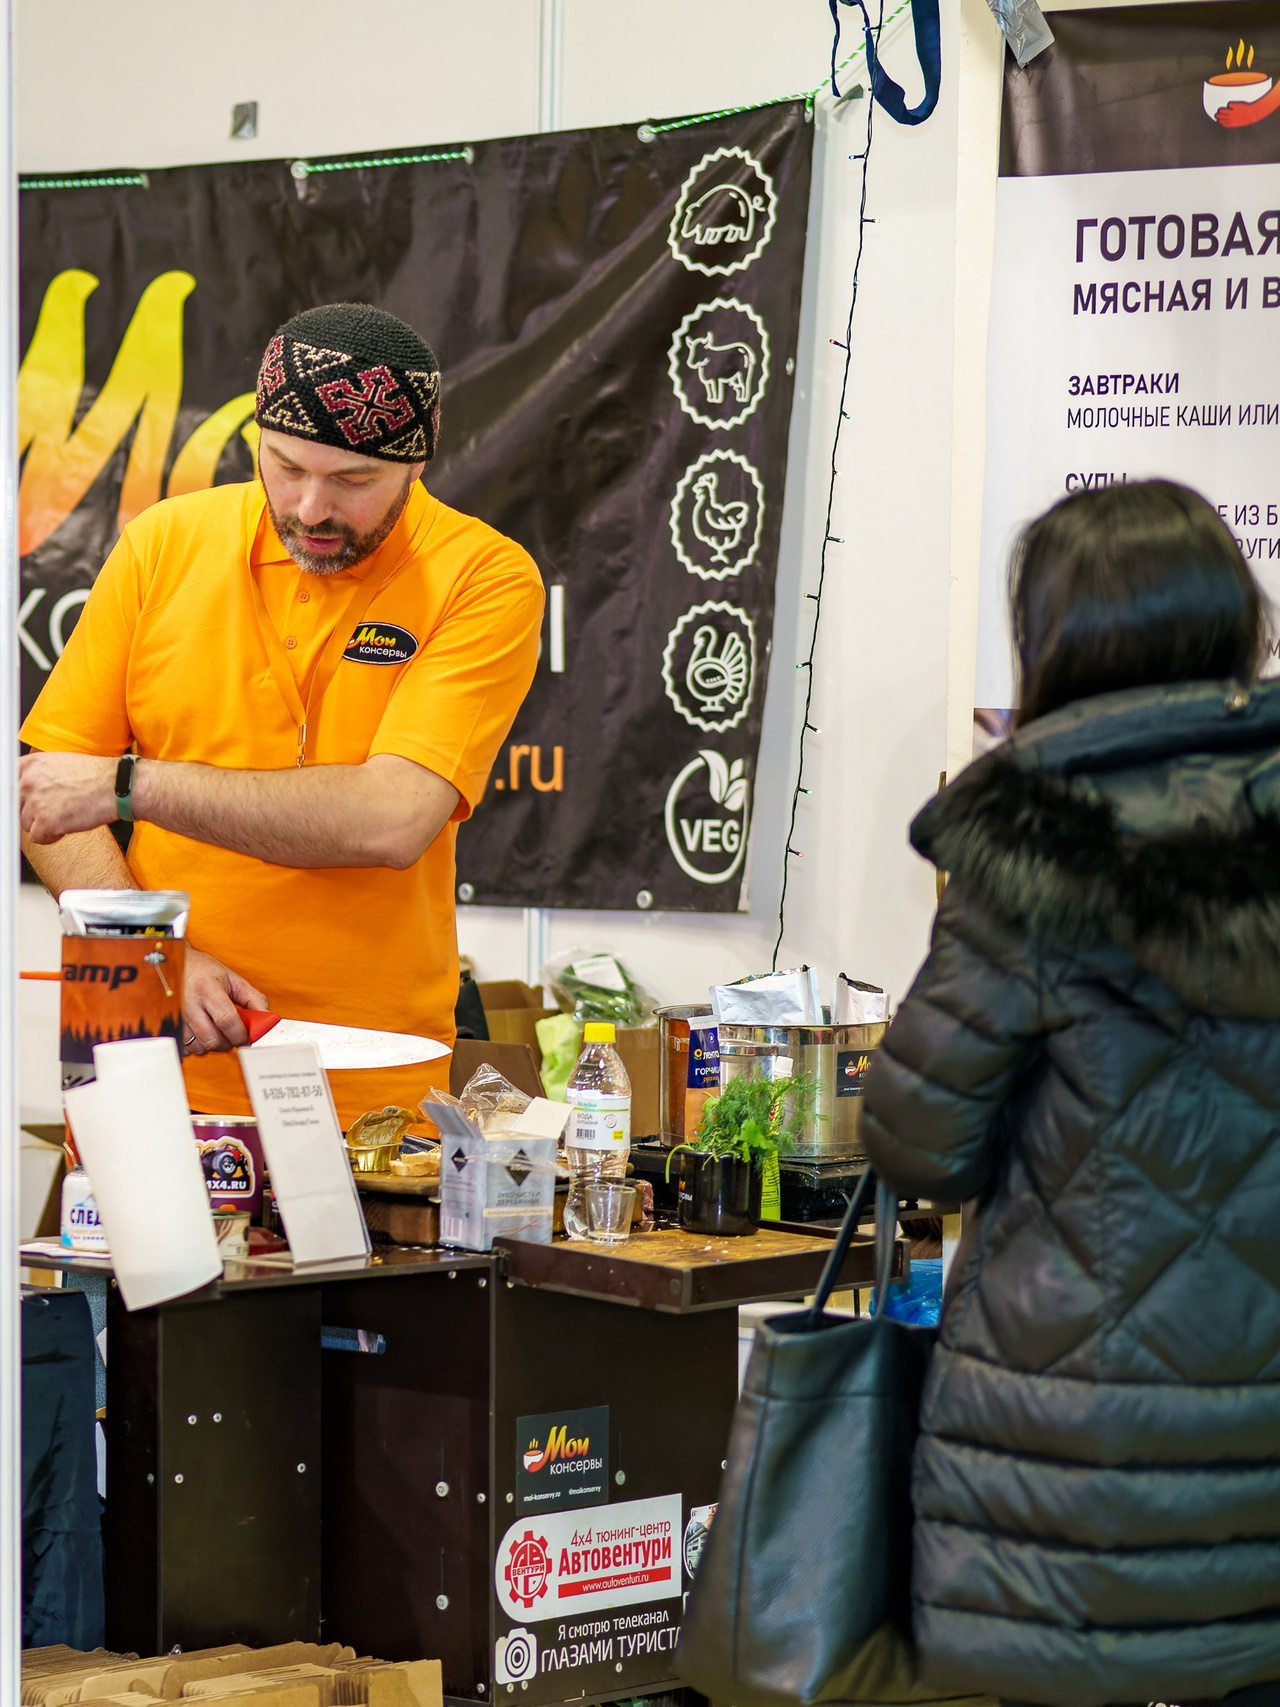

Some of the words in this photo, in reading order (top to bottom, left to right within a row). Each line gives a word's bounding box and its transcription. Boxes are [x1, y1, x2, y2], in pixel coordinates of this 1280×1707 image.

[1075, 210, 1280, 263] ГОТОВАЯ
[1073, 278, 1212, 315] МЯСНАЯ
[1225, 277, 1248, 310] И
[1067, 372, 1180, 396] ЗАВТРАКИ
[1067, 406, 1171, 429] МОЛОЧНЫЕ
[1176, 405, 1232, 427] КАШИ
[1238, 404, 1280, 425] ИЛИ
[1234, 504, 1260, 526] ИЗ
[355, 627, 397, 647] Мои
[679, 819, 741, 854] VEG
[545, 1424, 590, 1463] Мои
[549, 1457, 603, 1475] консервы
[595, 1520, 671, 1545] тюнинг-центр
[558, 1536, 672, 1577] Автовентури
[512, 1564, 546, 1577] ВЕНТУРИ
[582, 1571, 649, 1593] www.autoventuri.ru
[558, 1624, 566, 1641] Я
[568, 1618, 610, 1638] смотрю
[613, 1609, 670, 1630] телеканал
[541, 1638, 613, 1673] ГЛАЗАМИ
